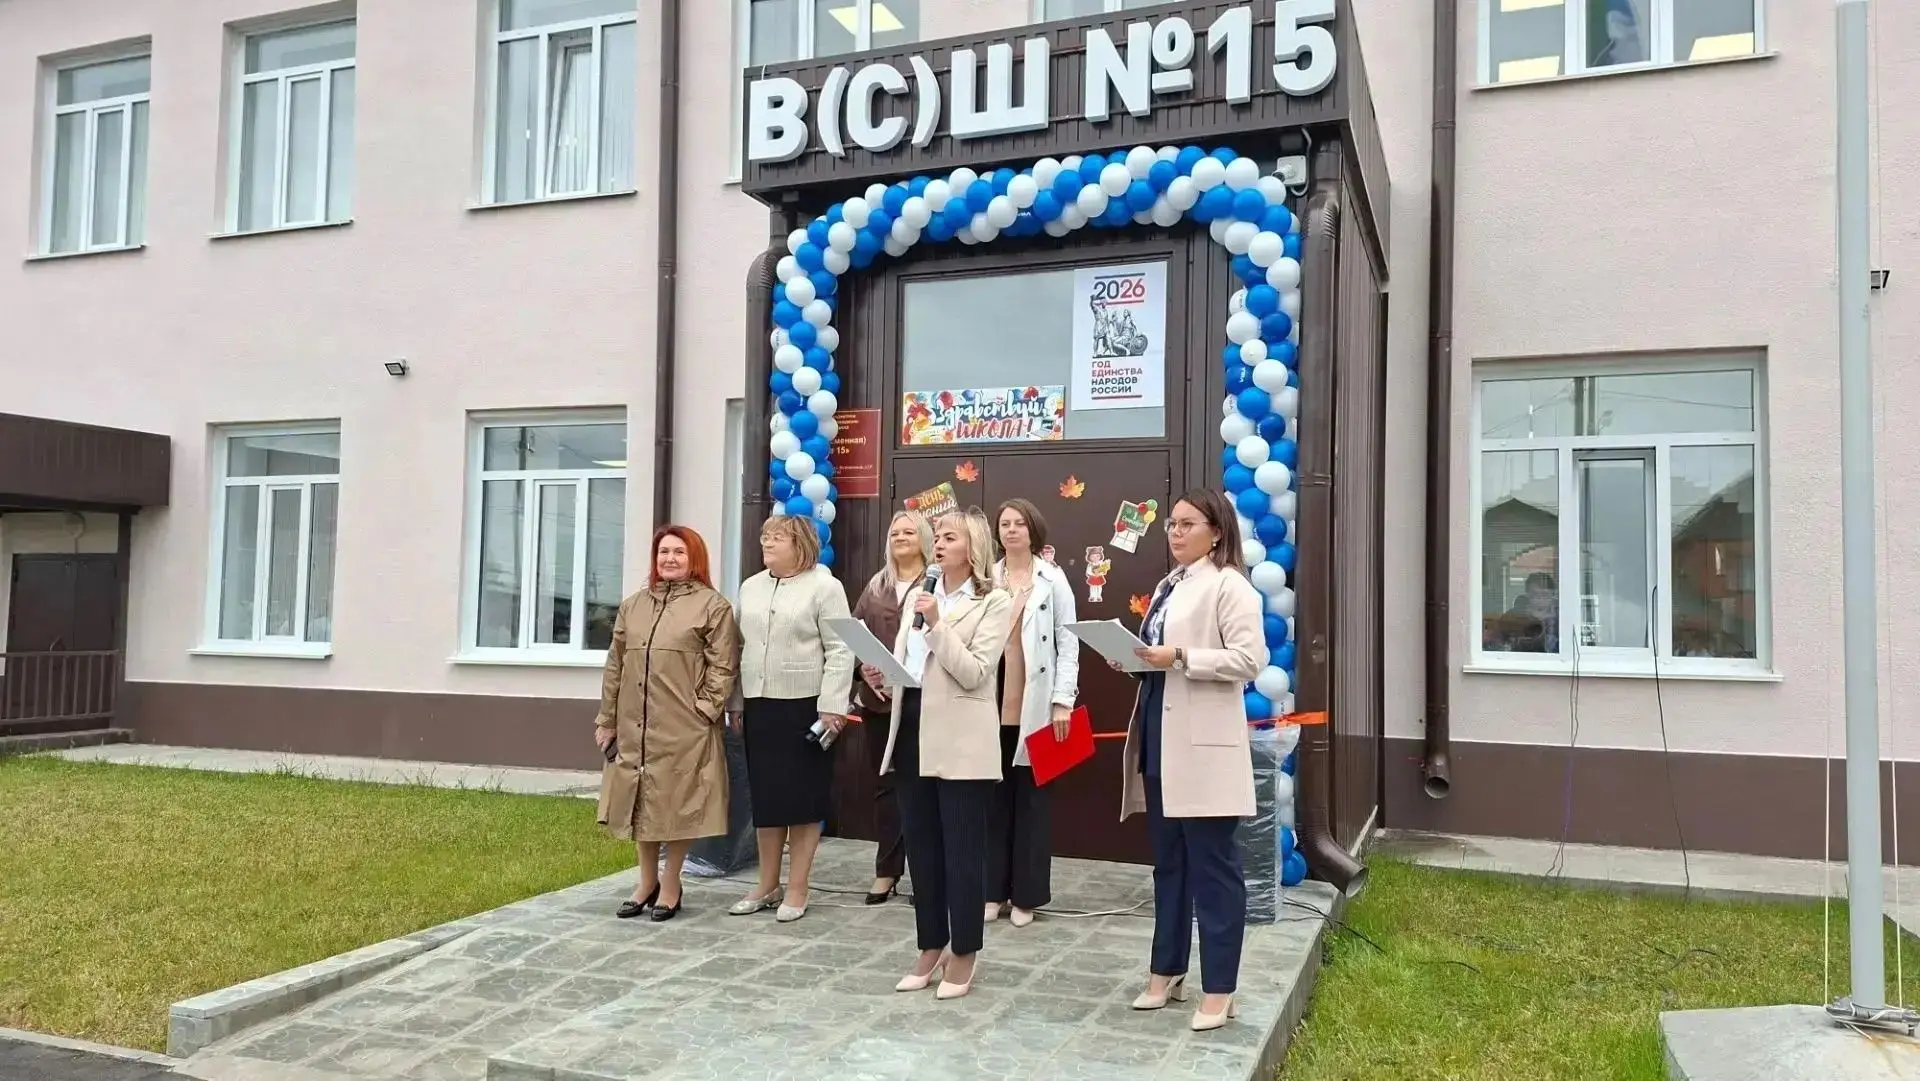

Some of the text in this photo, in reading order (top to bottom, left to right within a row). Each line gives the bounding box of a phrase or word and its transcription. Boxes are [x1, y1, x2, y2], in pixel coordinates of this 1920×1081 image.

[748, 37, 1049, 163] В(С)Ш
[1093, 278, 1146, 300] 2026
[1091, 360, 1111, 369] ГОД
[1091, 368, 1143, 378] ЕДИНСТВА
[1091, 376, 1138, 386] НАРОДОВ
[1091, 386, 1132, 394] РОССИИ
[956, 418, 1033, 439] ШКОЛА!
[831, 436, 866, 446] менная)
